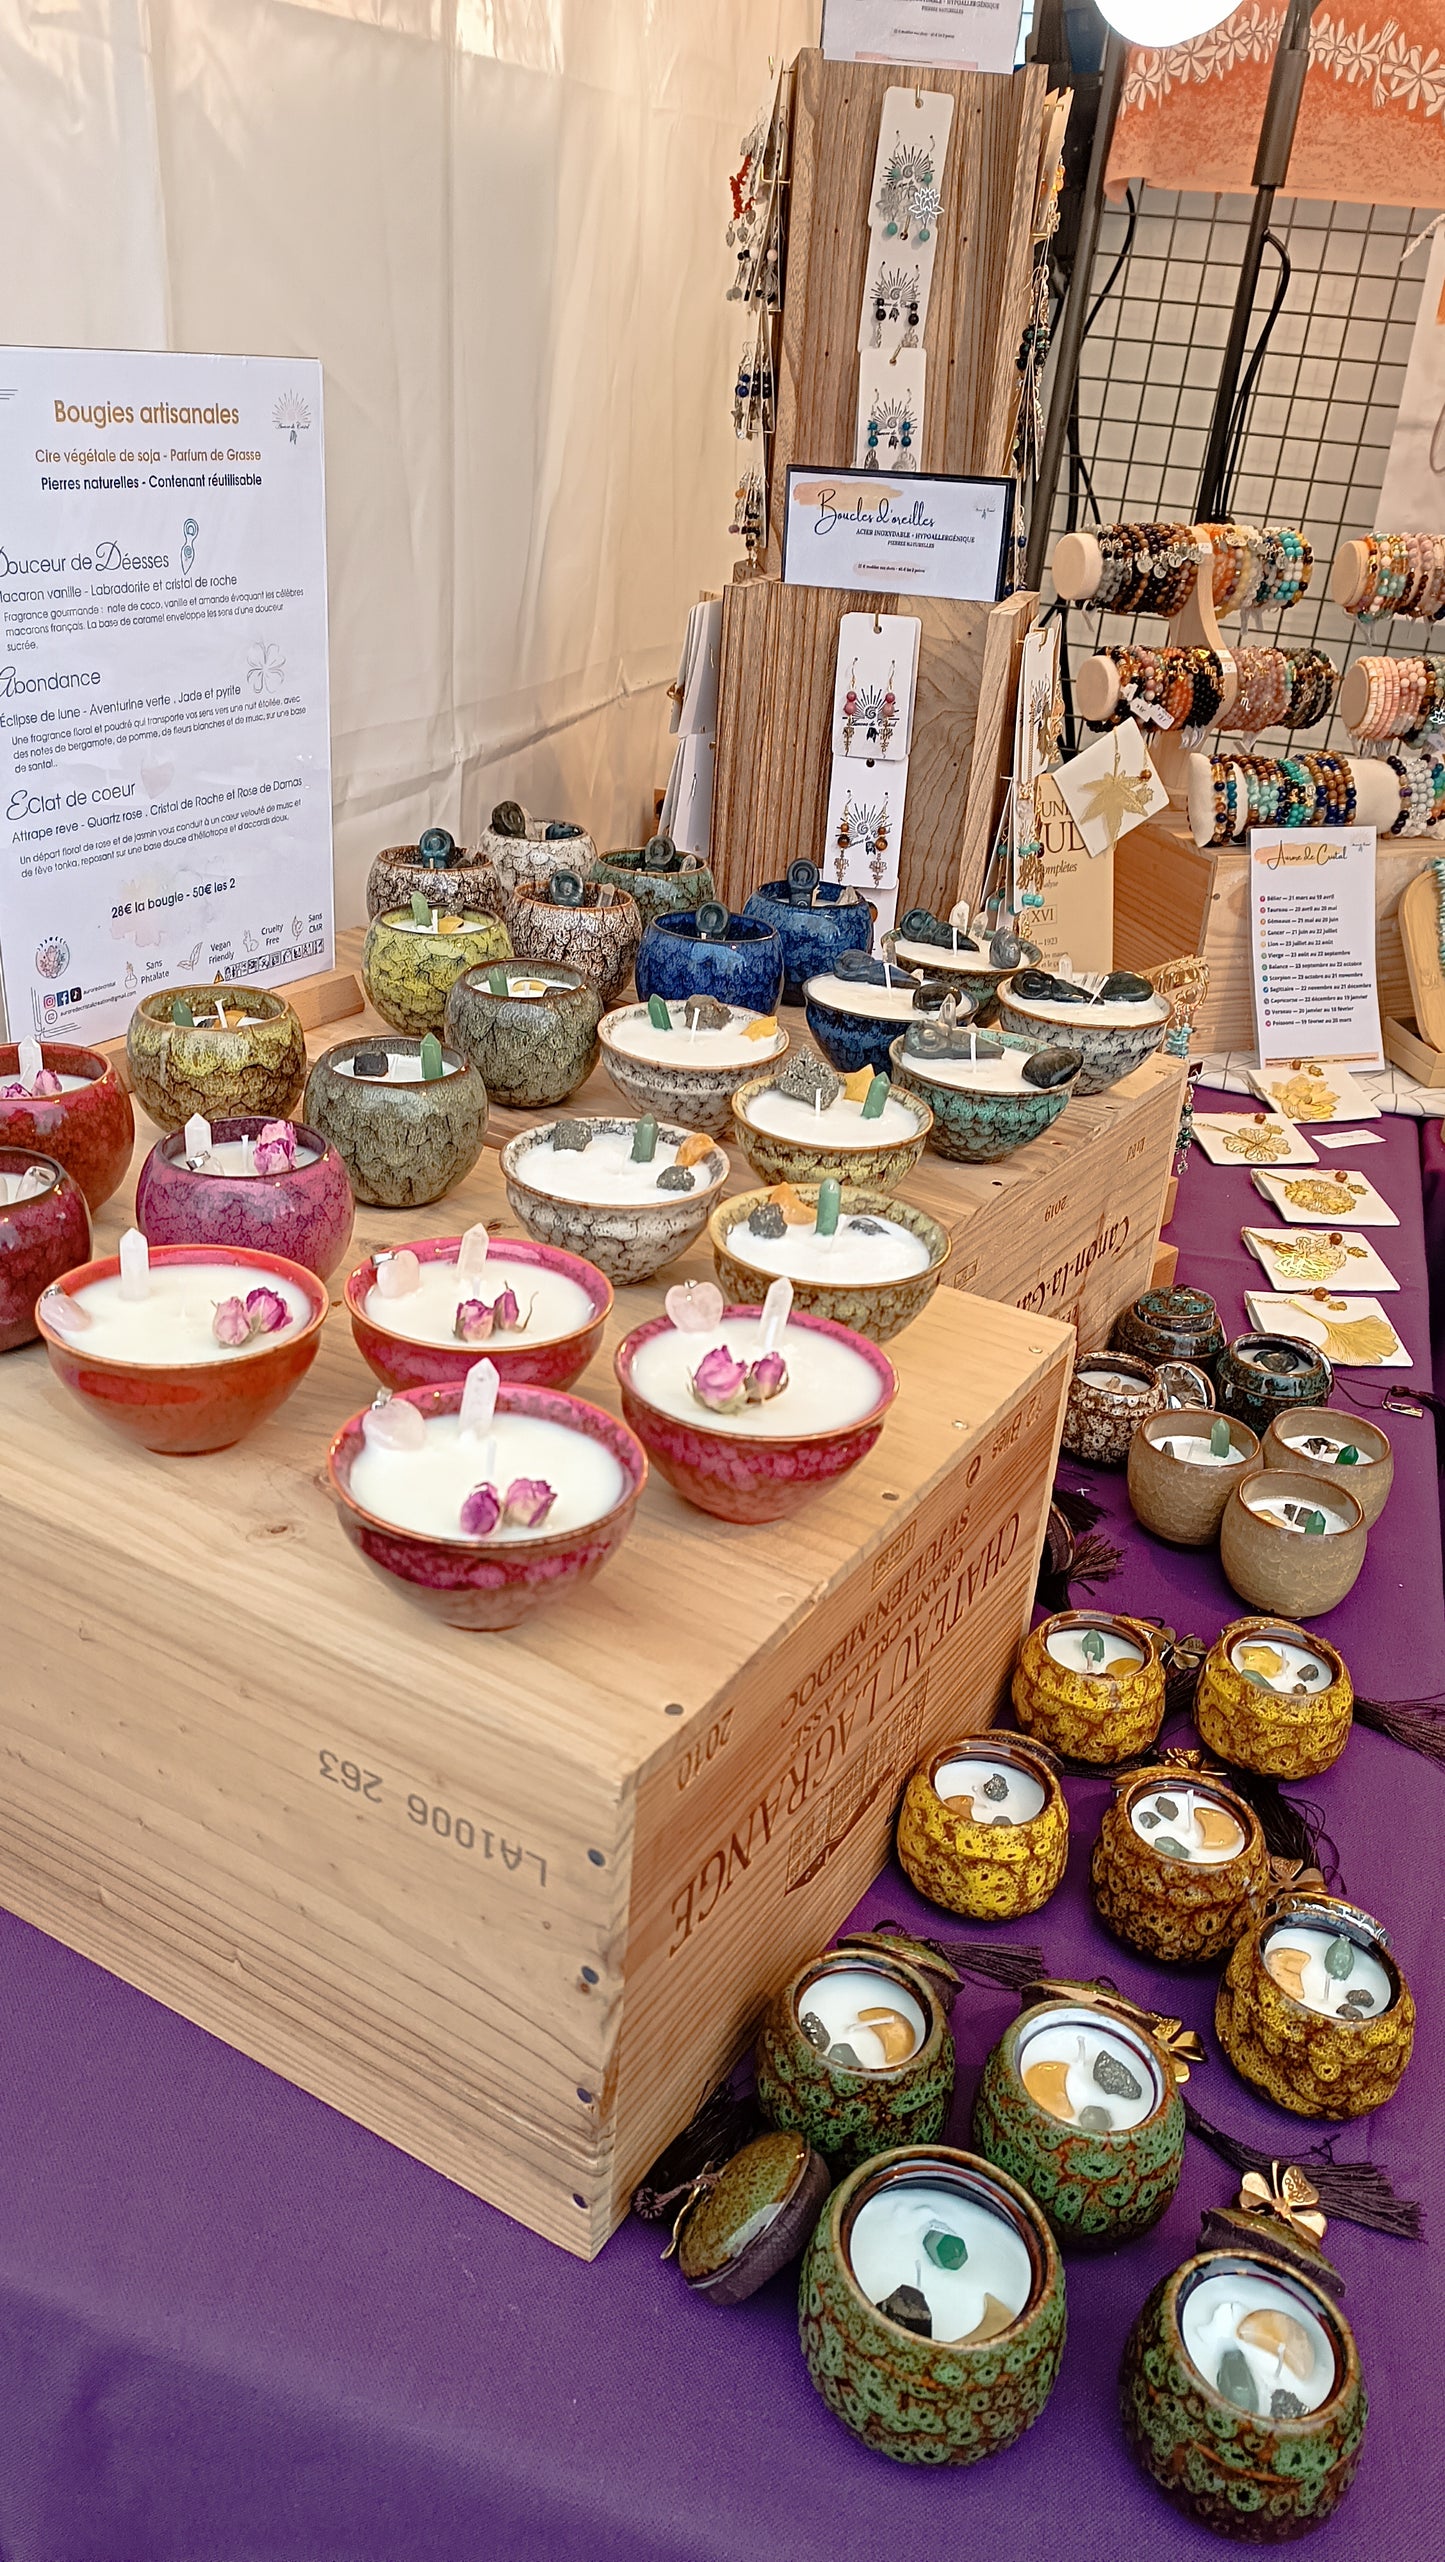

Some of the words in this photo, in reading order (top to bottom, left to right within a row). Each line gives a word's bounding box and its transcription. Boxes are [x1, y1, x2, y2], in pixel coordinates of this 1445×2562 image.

[54, 399, 134, 428] Bougies
[139, 401, 239, 424] artisanales
[35, 448, 61, 463] Cire
[63, 447, 116, 465] végétale
[119, 448, 134, 461] de
[137, 448, 160, 464] soja
[170, 448, 207, 461] Parfum
[209, 448, 223, 460] de
[226, 448, 261, 461] Grasse
[40, 476, 80, 490] Pierres
[83, 475, 139, 490] naturelles
[148, 473, 205, 488] Contenant
[207, 471, 262, 486] réutilisable
[814, 488, 873, 535] Boucles
[876, 498, 935, 528] d'oreilles
[856, 528, 873, 536] ACIER
[874, 529, 910, 539] INOXYDABLE
[915, 532, 976, 544] HYPOALLERGÉNIQUE
[70, 552, 92, 570] de
[94, 539, 169, 571] Déesses
[0, 590, 44, 602] acaron
[46, 585, 81, 599] vanille
[90, 580, 150, 596] Labradorite
[152, 579, 162, 591] et
[164, 576, 192, 590] cristal
[194, 576, 208, 588] de
[209, 574, 237, 586] roche
[6, 639, 38, 652] sucrée.
[0, 712, 37, 728] Éclipse
[40, 709, 55, 722] de
[57, 708, 80, 719] lune
[89, 698, 143, 715] Aventurine
[145, 694, 170, 707] verte
[177, 689, 202, 703] Jade
[204, 687, 213, 699] et
[215, 684, 240, 700] pyrite
[65, 789, 86, 807] de
[91, 782, 135, 802] coeur
[11, 827, 52, 843] Attrape
[55, 822, 78, 834] reve
[86, 812, 120, 828] Quartz
[122, 809, 142, 821] rose
[149, 800, 178, 815] Cristal
[180, 798, 193, 809] de
[194, 792, 224, 807] Roche
[225, 788, 235, 800] et
[237, 786, 257, 798] Rose
[259, 782, 271, 793] de
[272, 777, 302, 791] Damas
[110, 902, 132, 918] 28€
[134, 899, 145, 913] la
[147, 890, 183, 910] bougie
[192, 880, 212, 898] 50€
[213, 877, 227, 893] les
[229, 877, 235, 889] 2
[261, 922, 284, 936] Cruelty
[1032, 908, 1053, 922] XVI
[210, 940, 231, 953] Vegan
[265, 936, 280, 947] Free
[146, 959, 163, 970] Sans
[208, 950, 235, 965] Friendly
[140, 970, 170, 985] Phtalate
[1044, 1195, 1067, 1222] 2019
[907, 1547, 964, 1622] GRAND
[889, 1512, 1020, 1702] CHATEAU
[861, 1617, 902, 1675] CRU
[677, 1707, 734, 1792] 2010
[319, 1749, 384, 1803] 263
[669, 1670, 880, 1958] LAGRANGE
[406, 1793, 548, 1888] LA1006
